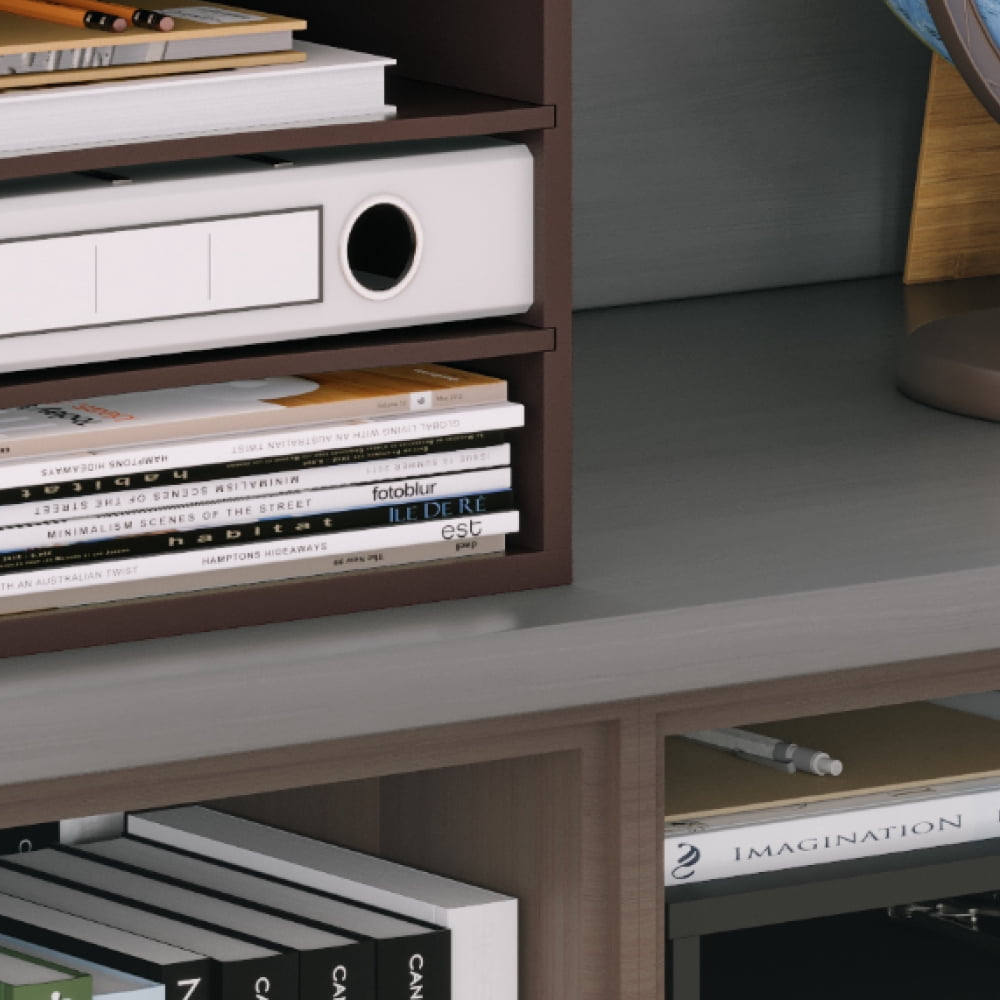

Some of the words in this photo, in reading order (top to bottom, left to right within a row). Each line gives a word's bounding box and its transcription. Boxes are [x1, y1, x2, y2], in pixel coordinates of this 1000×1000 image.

[354, 427, 380, 441] WITH
[382, 422, 418, 438] LIVING
[427, 418, 461, 433] GLOBAL
[267, 432, 333, 450] AUSTRALIAN
[40, 462, 105, 478] HIDEAWAYS
[153, 486, 208, 502] SCENES
[216, 475, 300, 495] MINIMALISM
[371, 480, 438, 503] fotoblur
[34, 500, 88, 516] STREET
[96, 496, 123, 510] THE
[129, 493, 146, 506] OF
[47, 520, 133, 540] MINIMALISM
[141, 513, 196, 528] SCENES
[202, 510, 219, 521] OF
[226, 506, 252, 518] THE
[259, 497, 313, 513] STREET
[423, 500, 453, 520] DE
[168, 517, 333, 548] habitat
[441, 519, 483, 540] est
[201, 550, 261, 566] HAMPTONS
[264, 541, 328, 559] HIDEAWAYS
[17, 578, 33, 590] AN
[35, 570, 102, 588] AUSTRALIAN
[103, 564, 140, 580] TWIST
[733, 814, 964, 861] IMAGINATION
